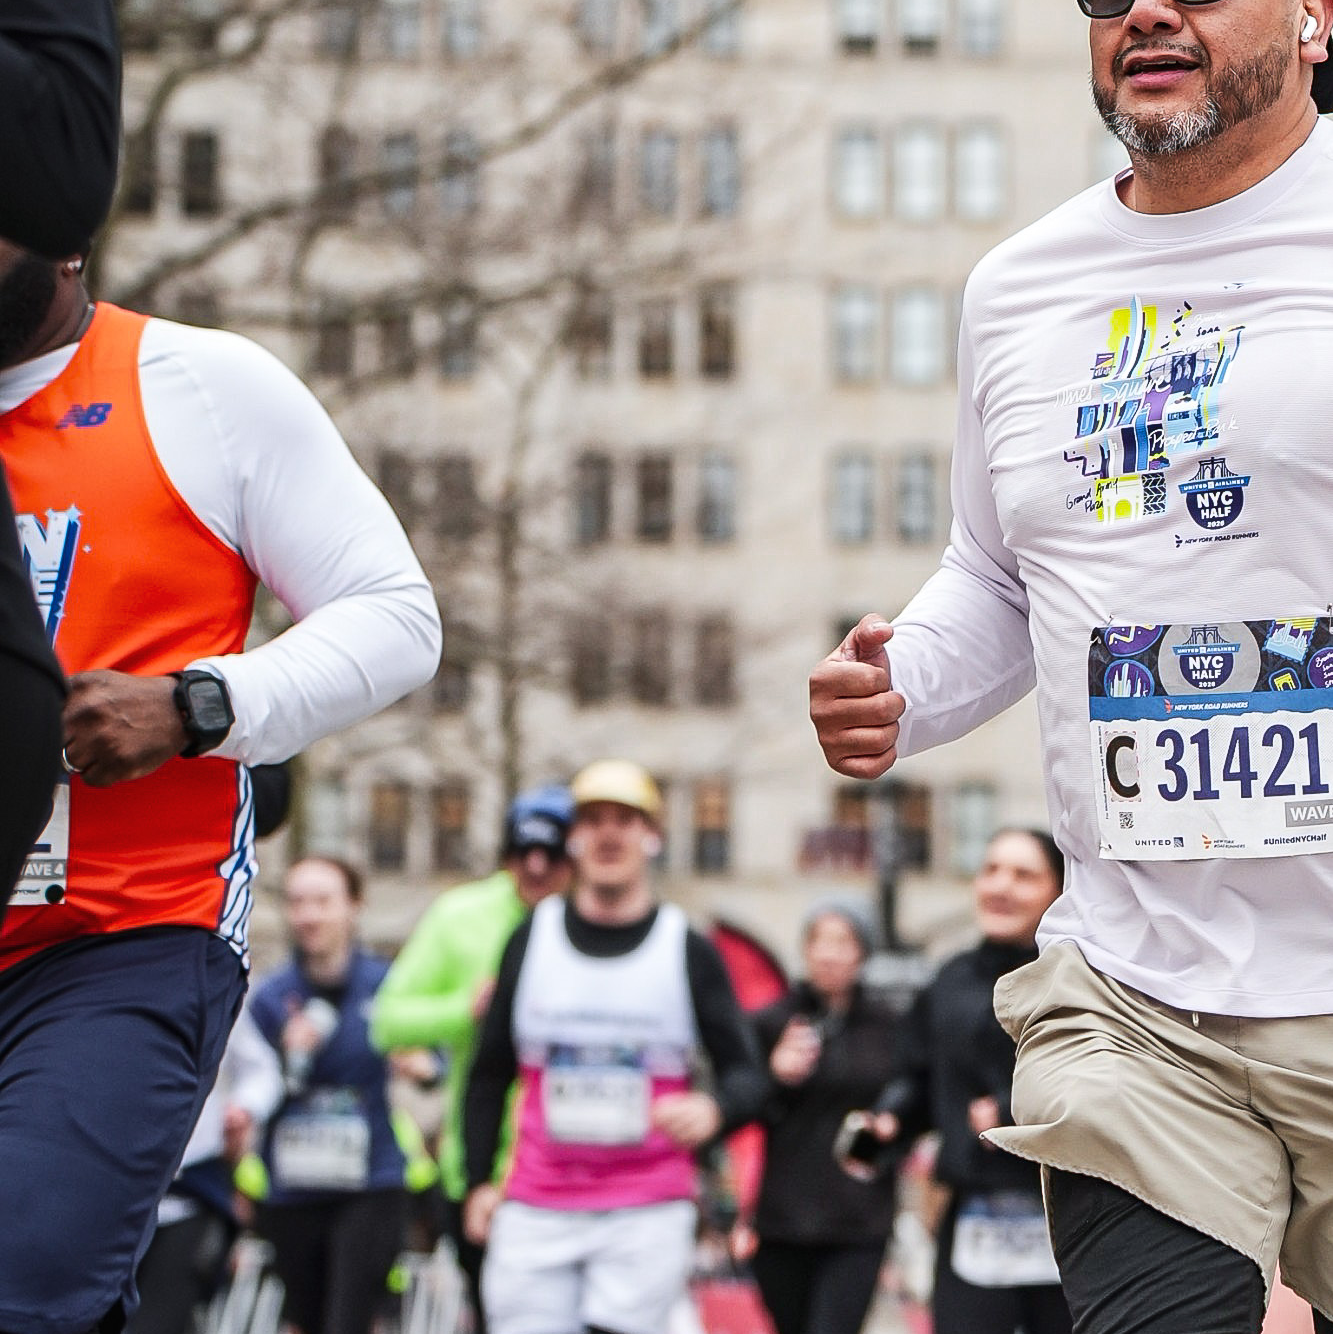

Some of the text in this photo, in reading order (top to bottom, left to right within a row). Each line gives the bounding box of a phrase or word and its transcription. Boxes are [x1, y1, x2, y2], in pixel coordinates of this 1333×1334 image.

[1102, 375, 1171, 404] Square
[1148, 427, 1199, 451] Prospect
[1206, 413, 1239, 437] Park
[1183, 479, 1245, 491] UNITED AIRLINES
[1066, 487, 1092, 510] Grand
[1196, 490, 1233, 508] NYC
[1201, 506, 1231, 519] HALF
[1232, 532, 1259, 540] RUNNERS
[1188, 655, 1223, 670] NYC
[1192, 669, 1221, 680] HALF
[1221, 701, 1249, 709] RUNNERS
[1105, 735, 1141, 798] C
[1155, 722, 1329, 802] 31421
[1264, 833, 1327, 845] #UnitedNYCHalf
[21, 862, 64, 876] AVE 4
